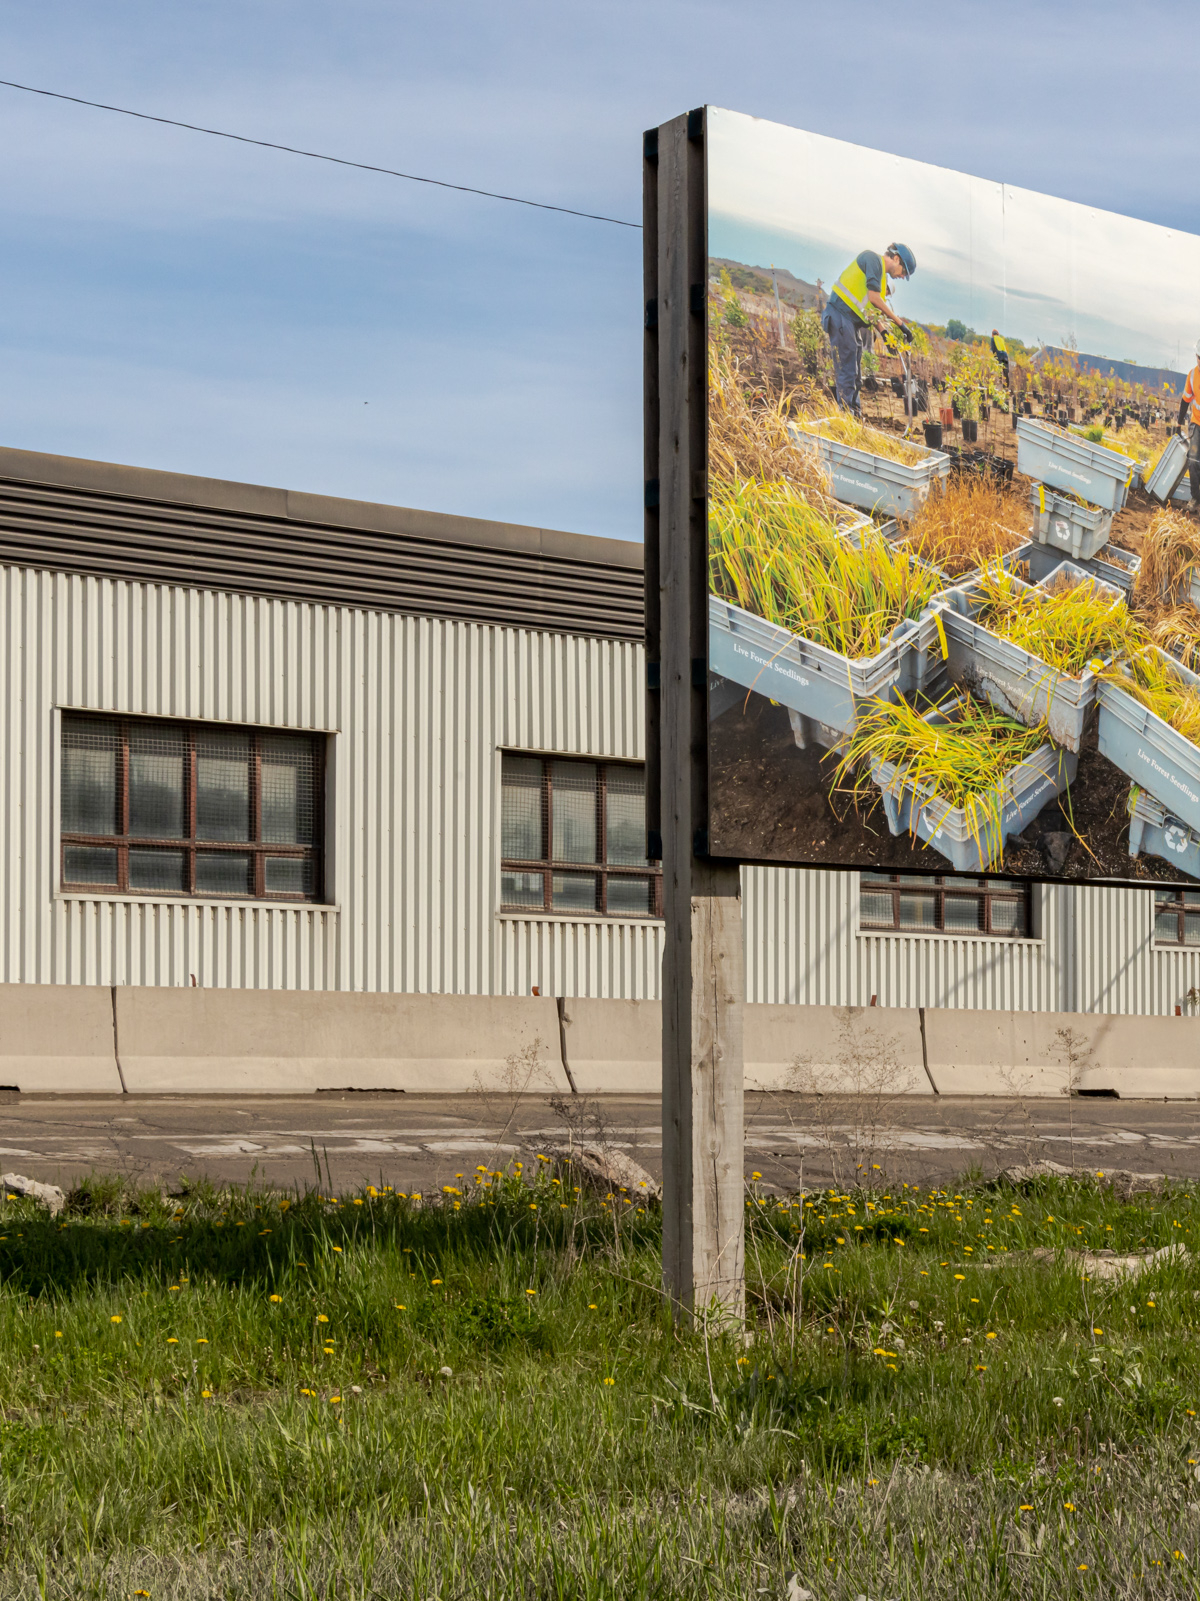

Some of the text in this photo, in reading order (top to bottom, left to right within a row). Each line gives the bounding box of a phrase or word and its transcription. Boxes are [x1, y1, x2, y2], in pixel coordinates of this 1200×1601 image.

[840, 474, 855, 485] Forest
[856, 480, 878, 493] Seedlings
[733, 643, 810, 686] Live Forest Seedlings
[988, 671, 1006, 687] Forest
[1137, 748, 1199, 803] Live Forest Seedlings
[1005, 809, 1018, 823] Live
